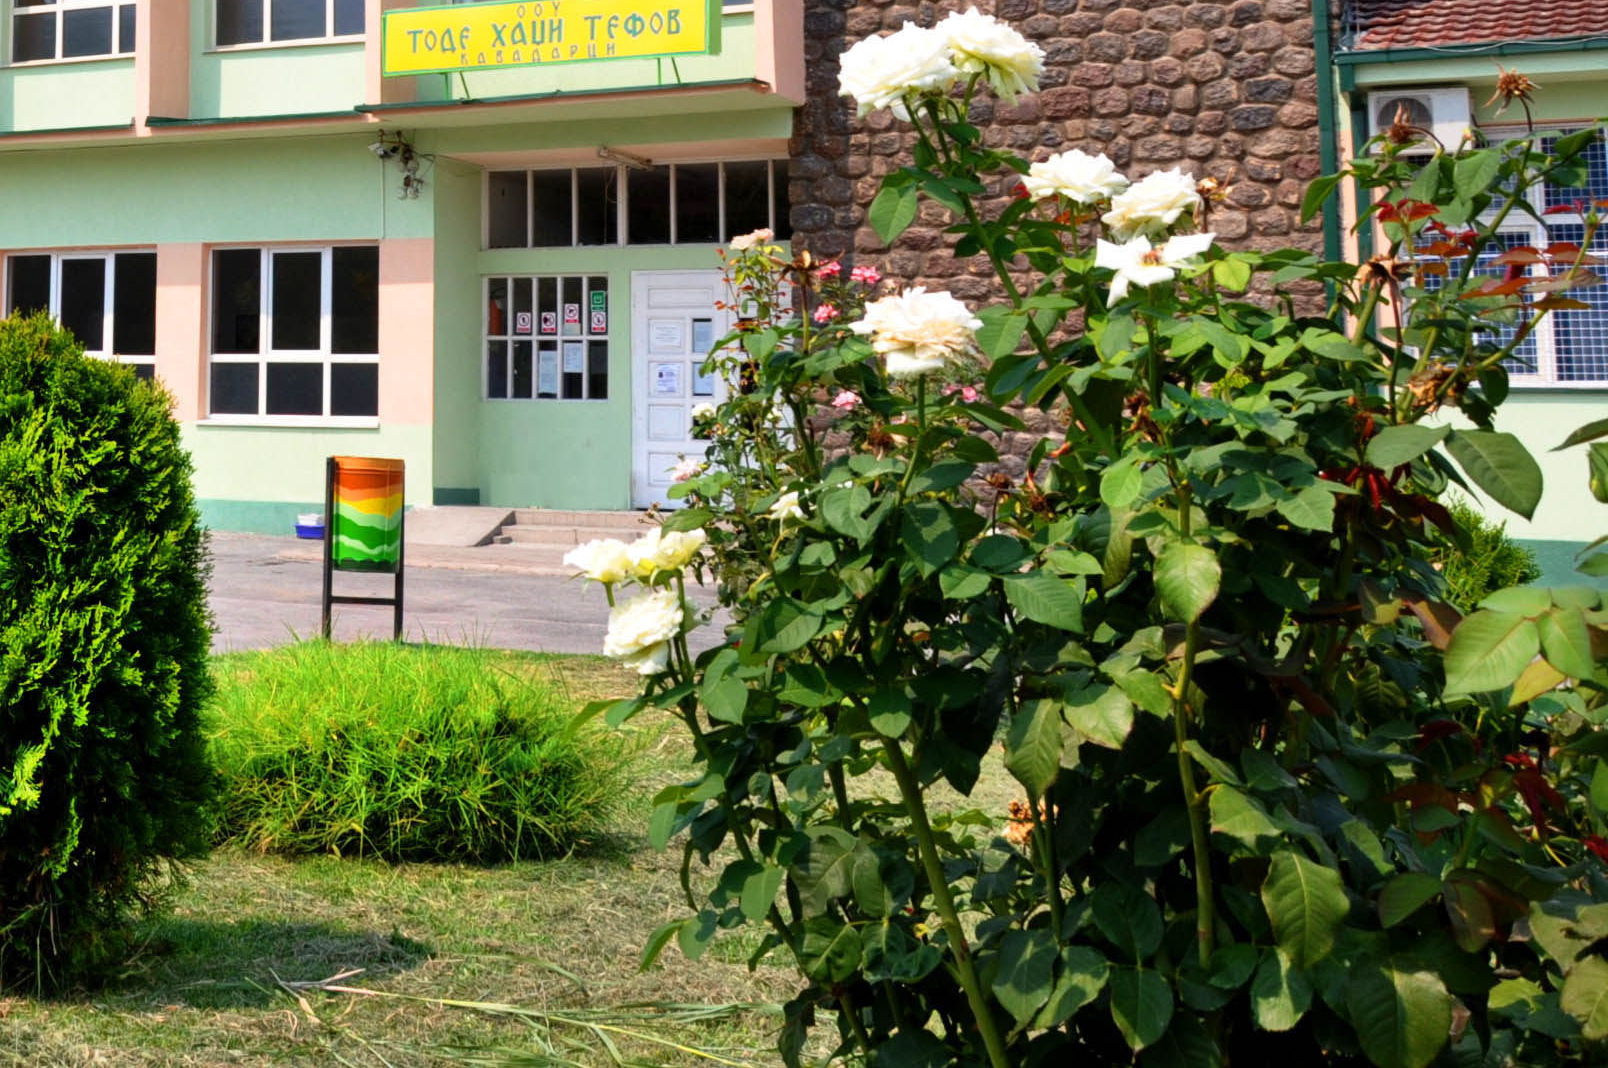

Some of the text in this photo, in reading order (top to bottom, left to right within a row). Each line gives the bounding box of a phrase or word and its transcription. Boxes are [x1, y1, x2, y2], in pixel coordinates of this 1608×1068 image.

[516, 1, 561, 18] ООУ
[406, 9, 681, 53] ТОДЕ ХАЏИ ТЕФОВ
[460, 42, 616, 65] КАВАДАРЦИ
